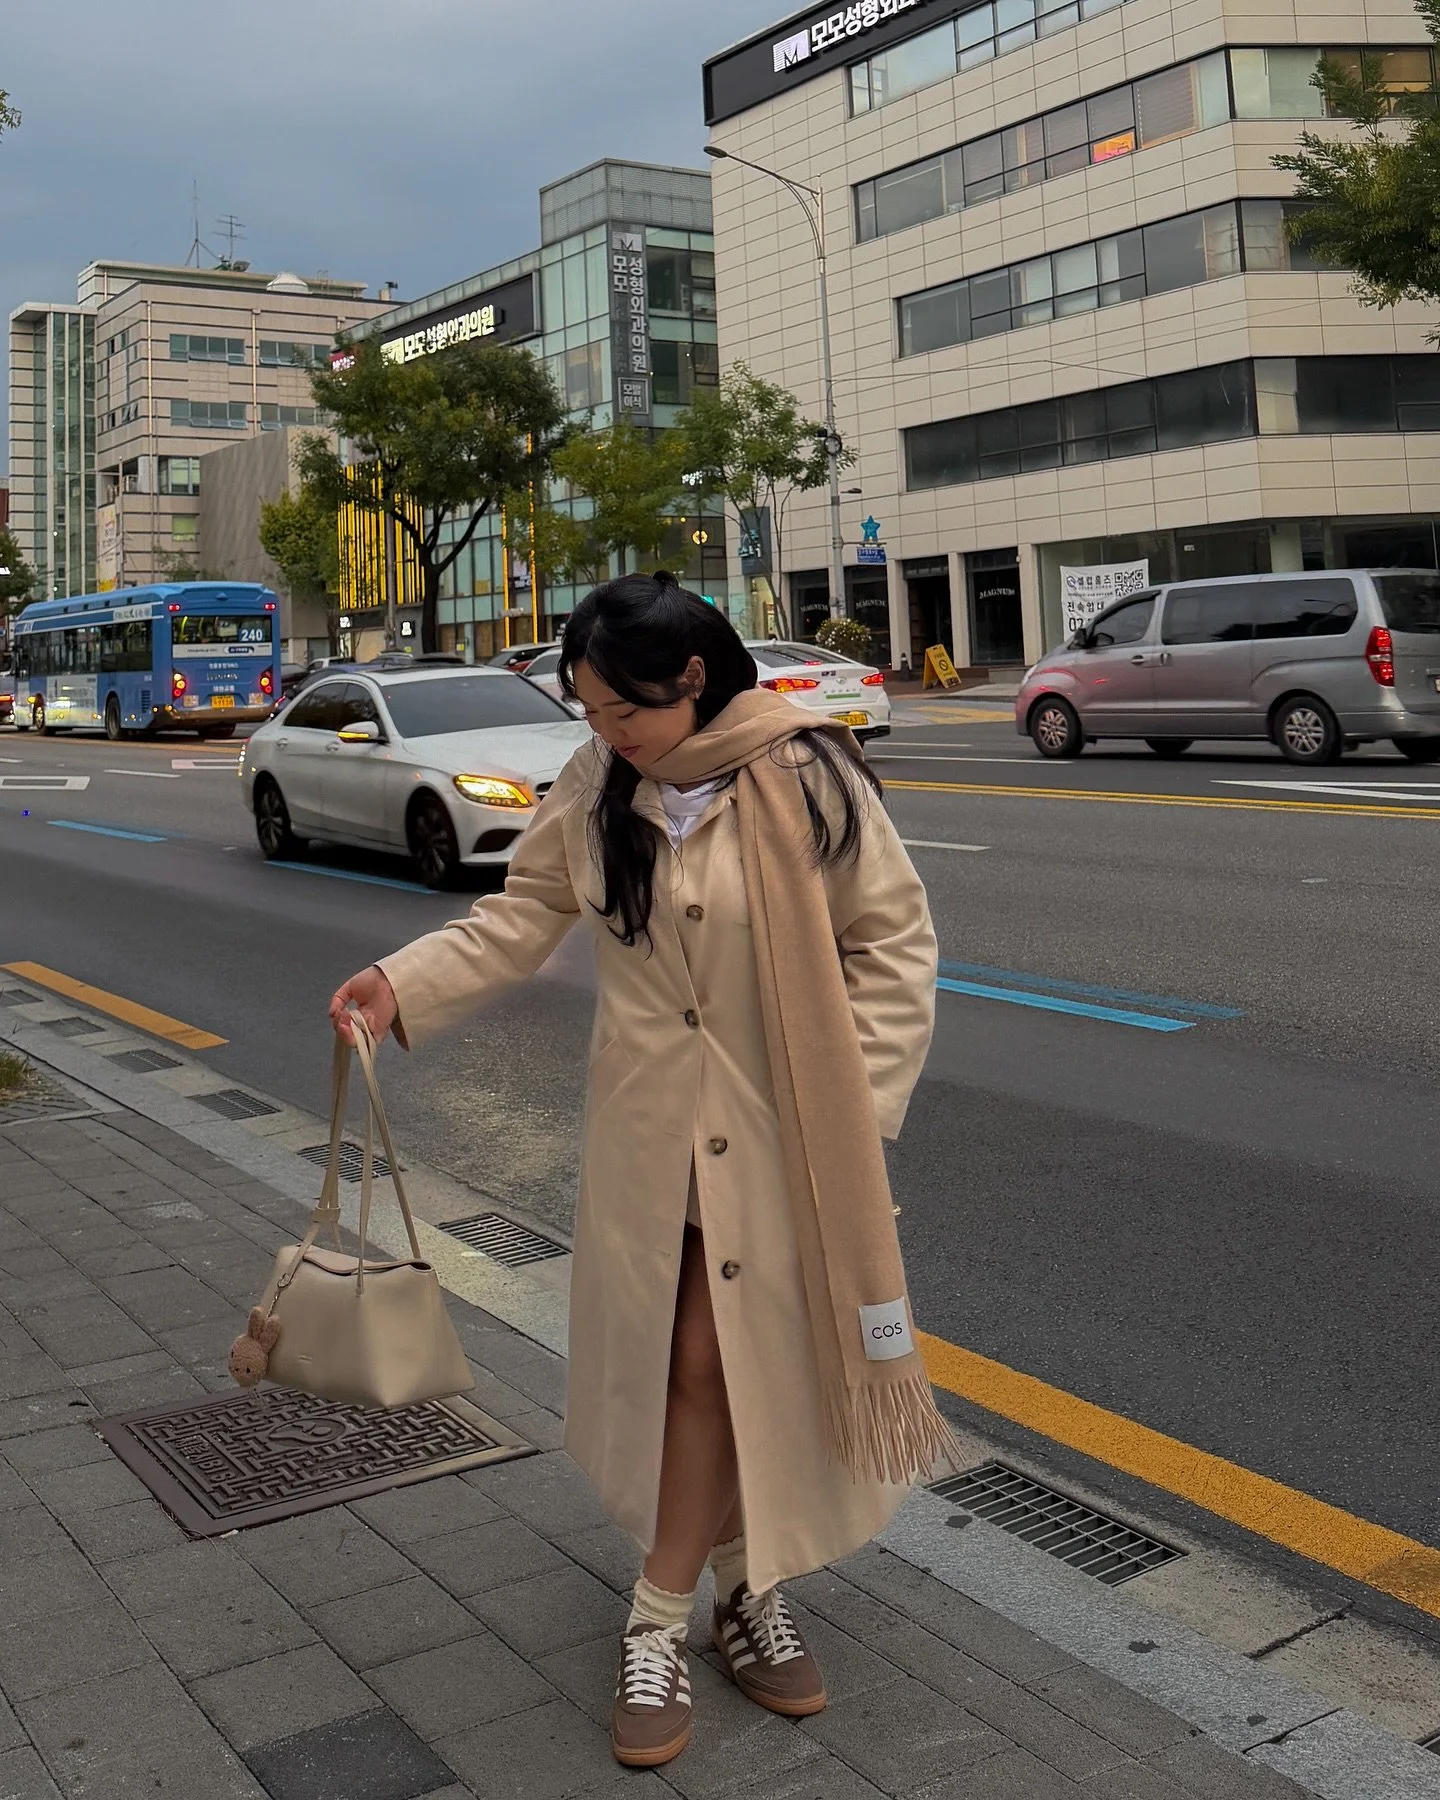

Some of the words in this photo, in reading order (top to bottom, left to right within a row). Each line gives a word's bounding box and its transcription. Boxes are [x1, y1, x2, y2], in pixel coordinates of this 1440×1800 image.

[613, 254, 629, 293] 모모
[629, 256, 647, 374] 성형외과의원
[240, 628, 264, 642] 240
[871, 1321, 903, 1340] COS
